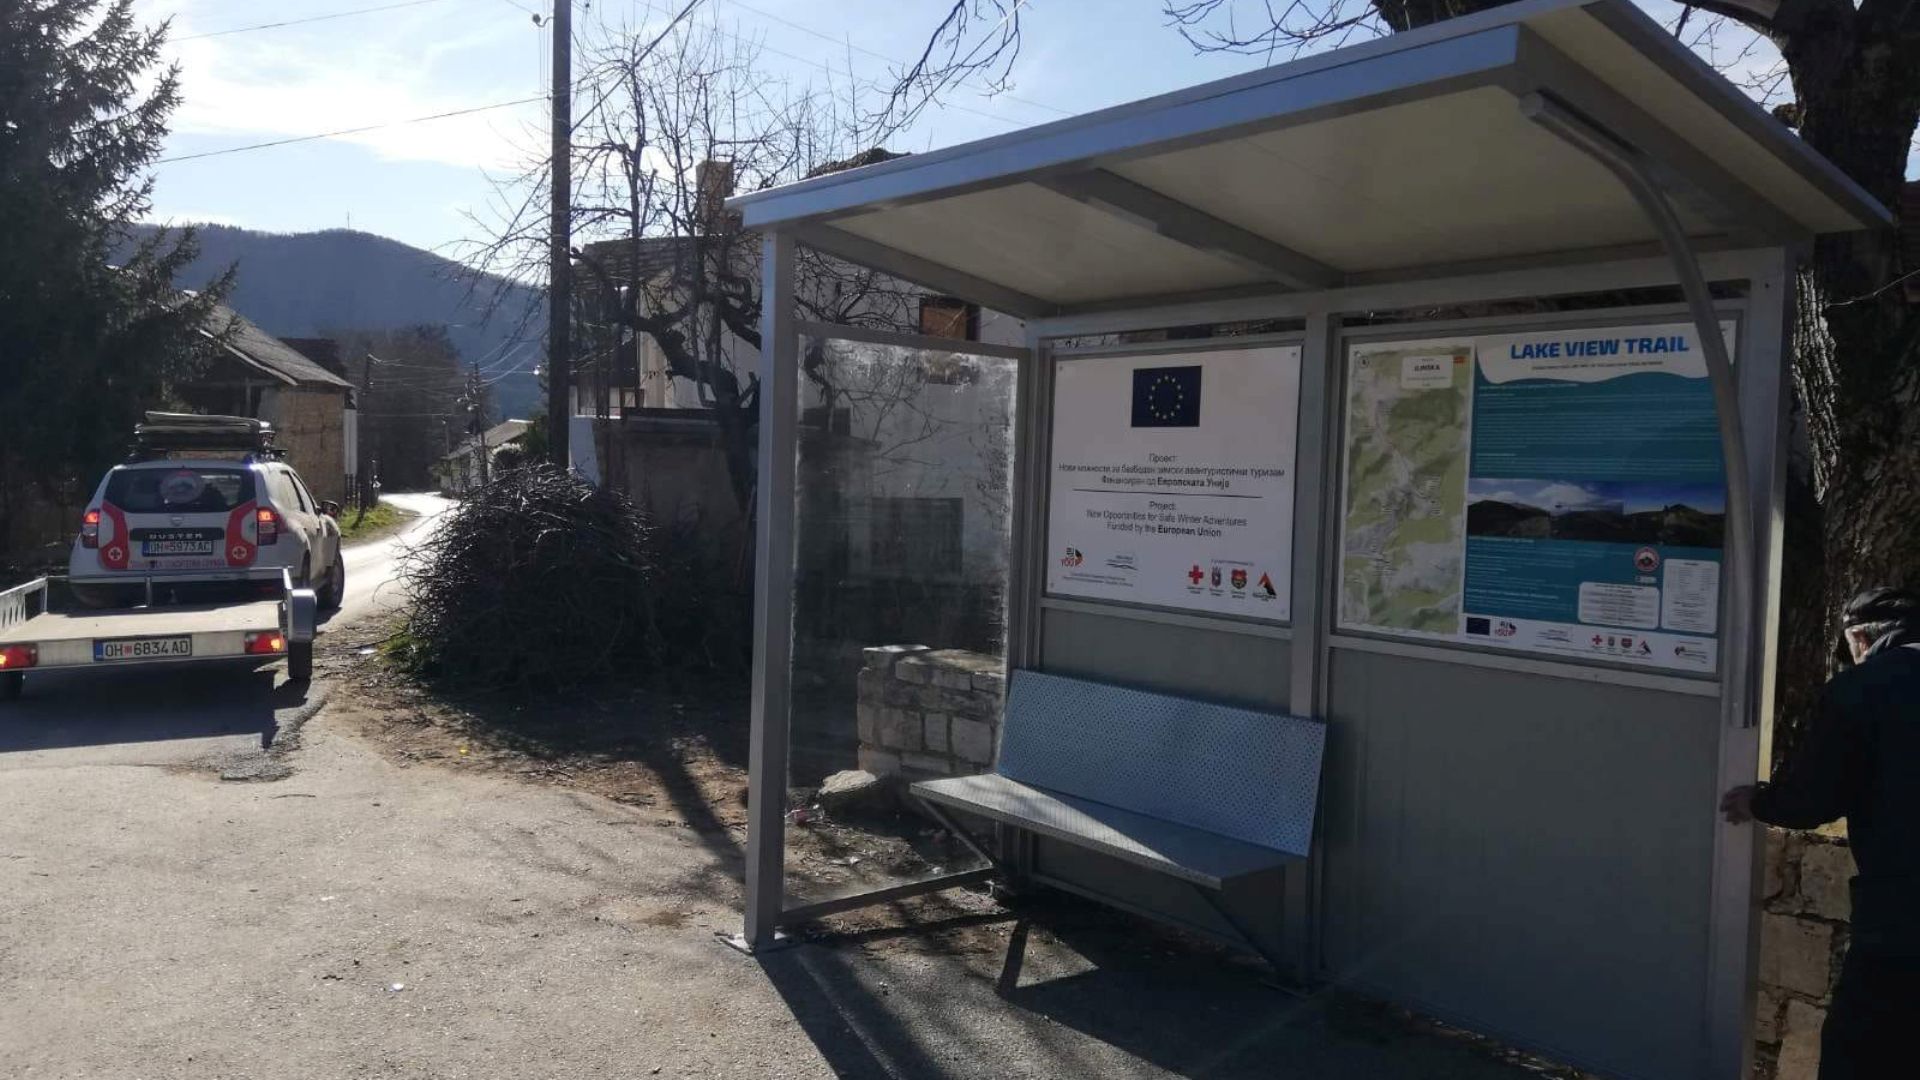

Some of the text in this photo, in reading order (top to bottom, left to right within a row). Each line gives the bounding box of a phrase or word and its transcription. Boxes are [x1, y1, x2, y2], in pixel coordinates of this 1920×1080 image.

[1511, 336, 1689, 359] LAKE VIEW TRAIL
[1157, 476, 1204, 488] Европската
[1177, 513, 1202, 523] Winter
[1203, 515, 1248, 526] Adventures
[1107, 523, 1222, 537] Funded by the European Union
[105, 640, 188, 657] OH 6834 AD
